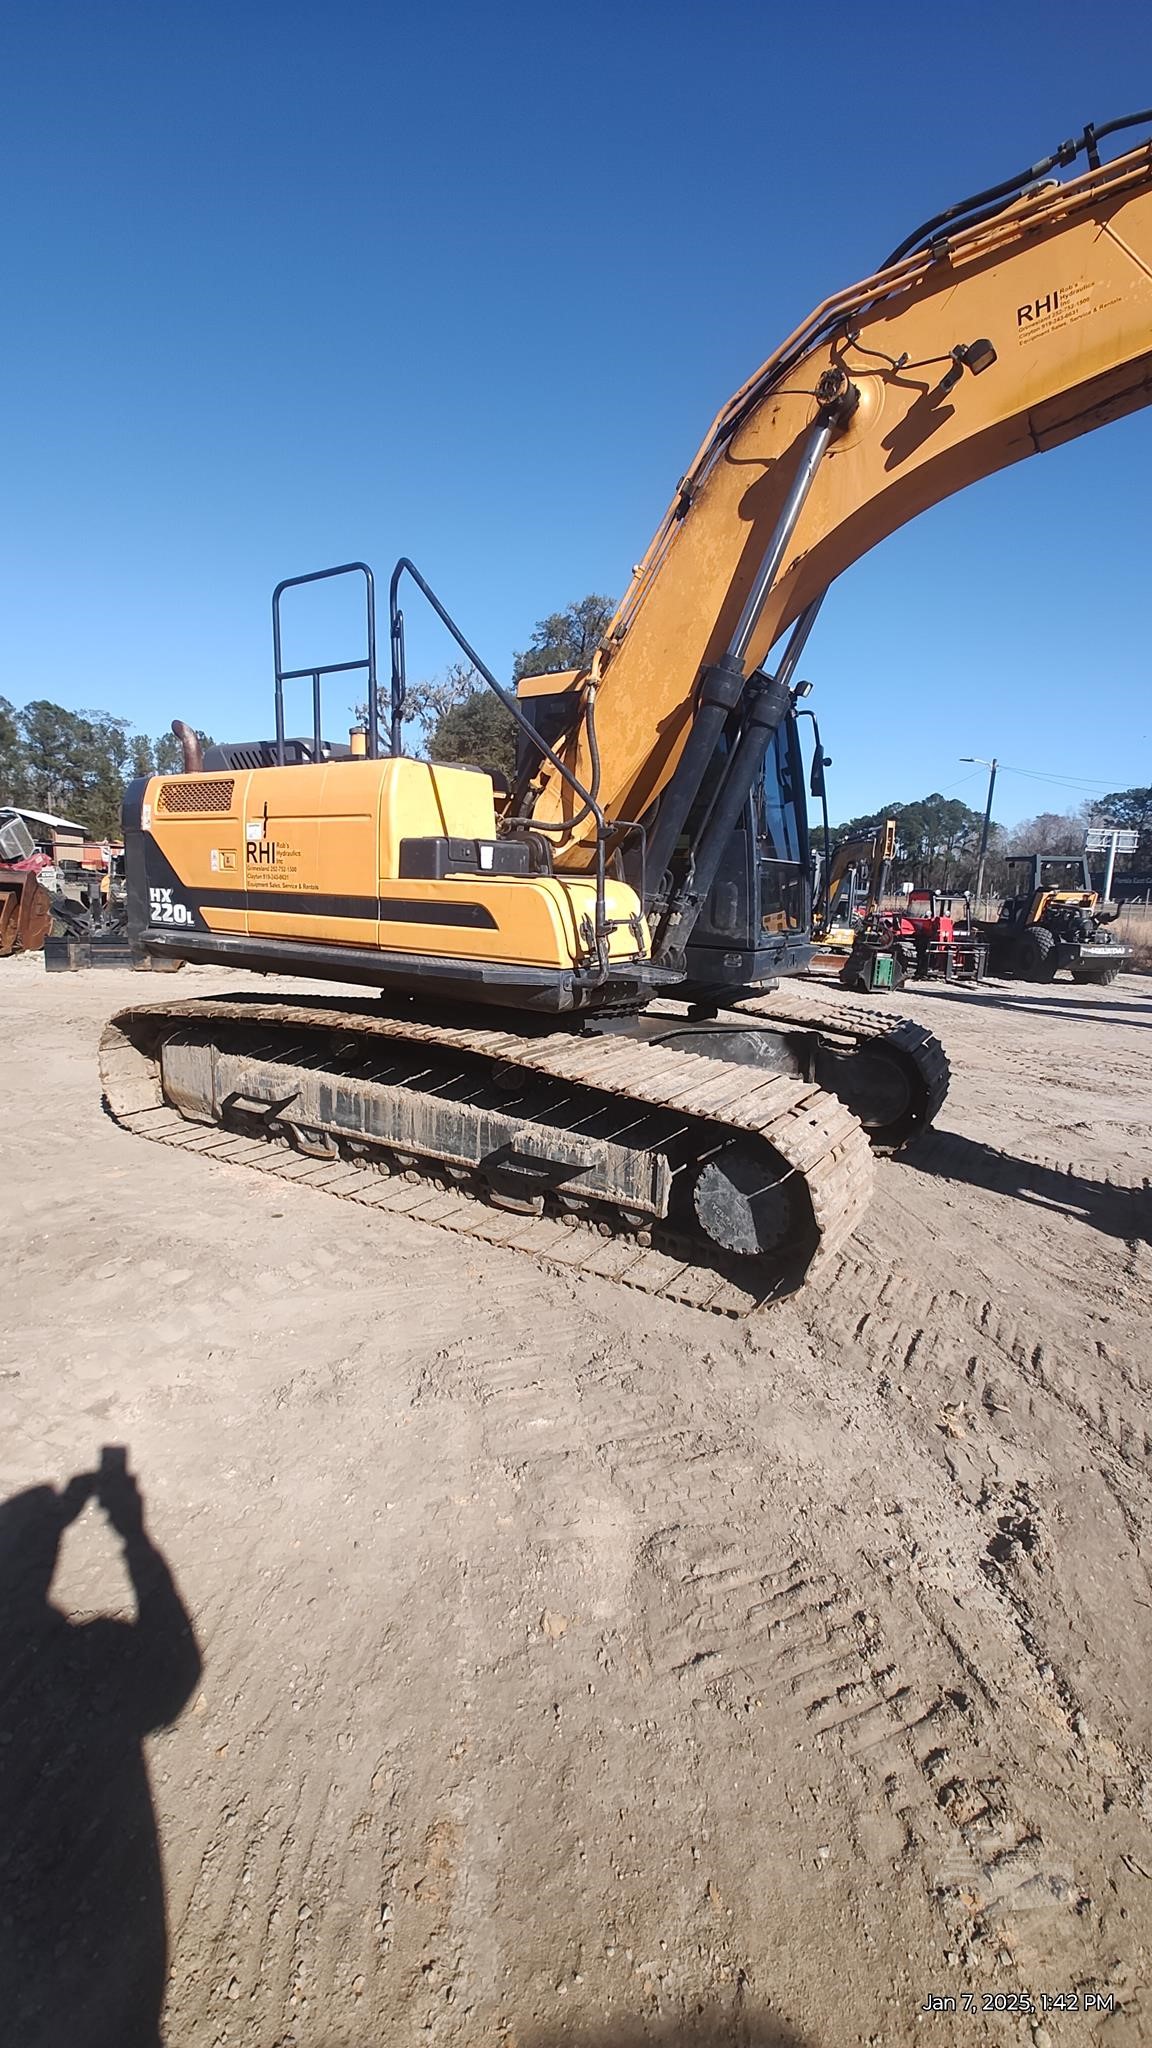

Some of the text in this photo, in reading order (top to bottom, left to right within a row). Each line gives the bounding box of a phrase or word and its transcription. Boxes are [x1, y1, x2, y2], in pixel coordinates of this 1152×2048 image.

[1059, 282, 1095, 300] Hydraulics
[1017, 291, 1059, 327] RHI
[1019, 329, 1050, 346] Equipment
[1069, 310, 1092, 323] Service
[1099, 296, 1122, 310] Rentals
[246, 842, 275, 864] RHI
[150, 888, 172, 903] HX
[150, 903, 195, 924] 220L
